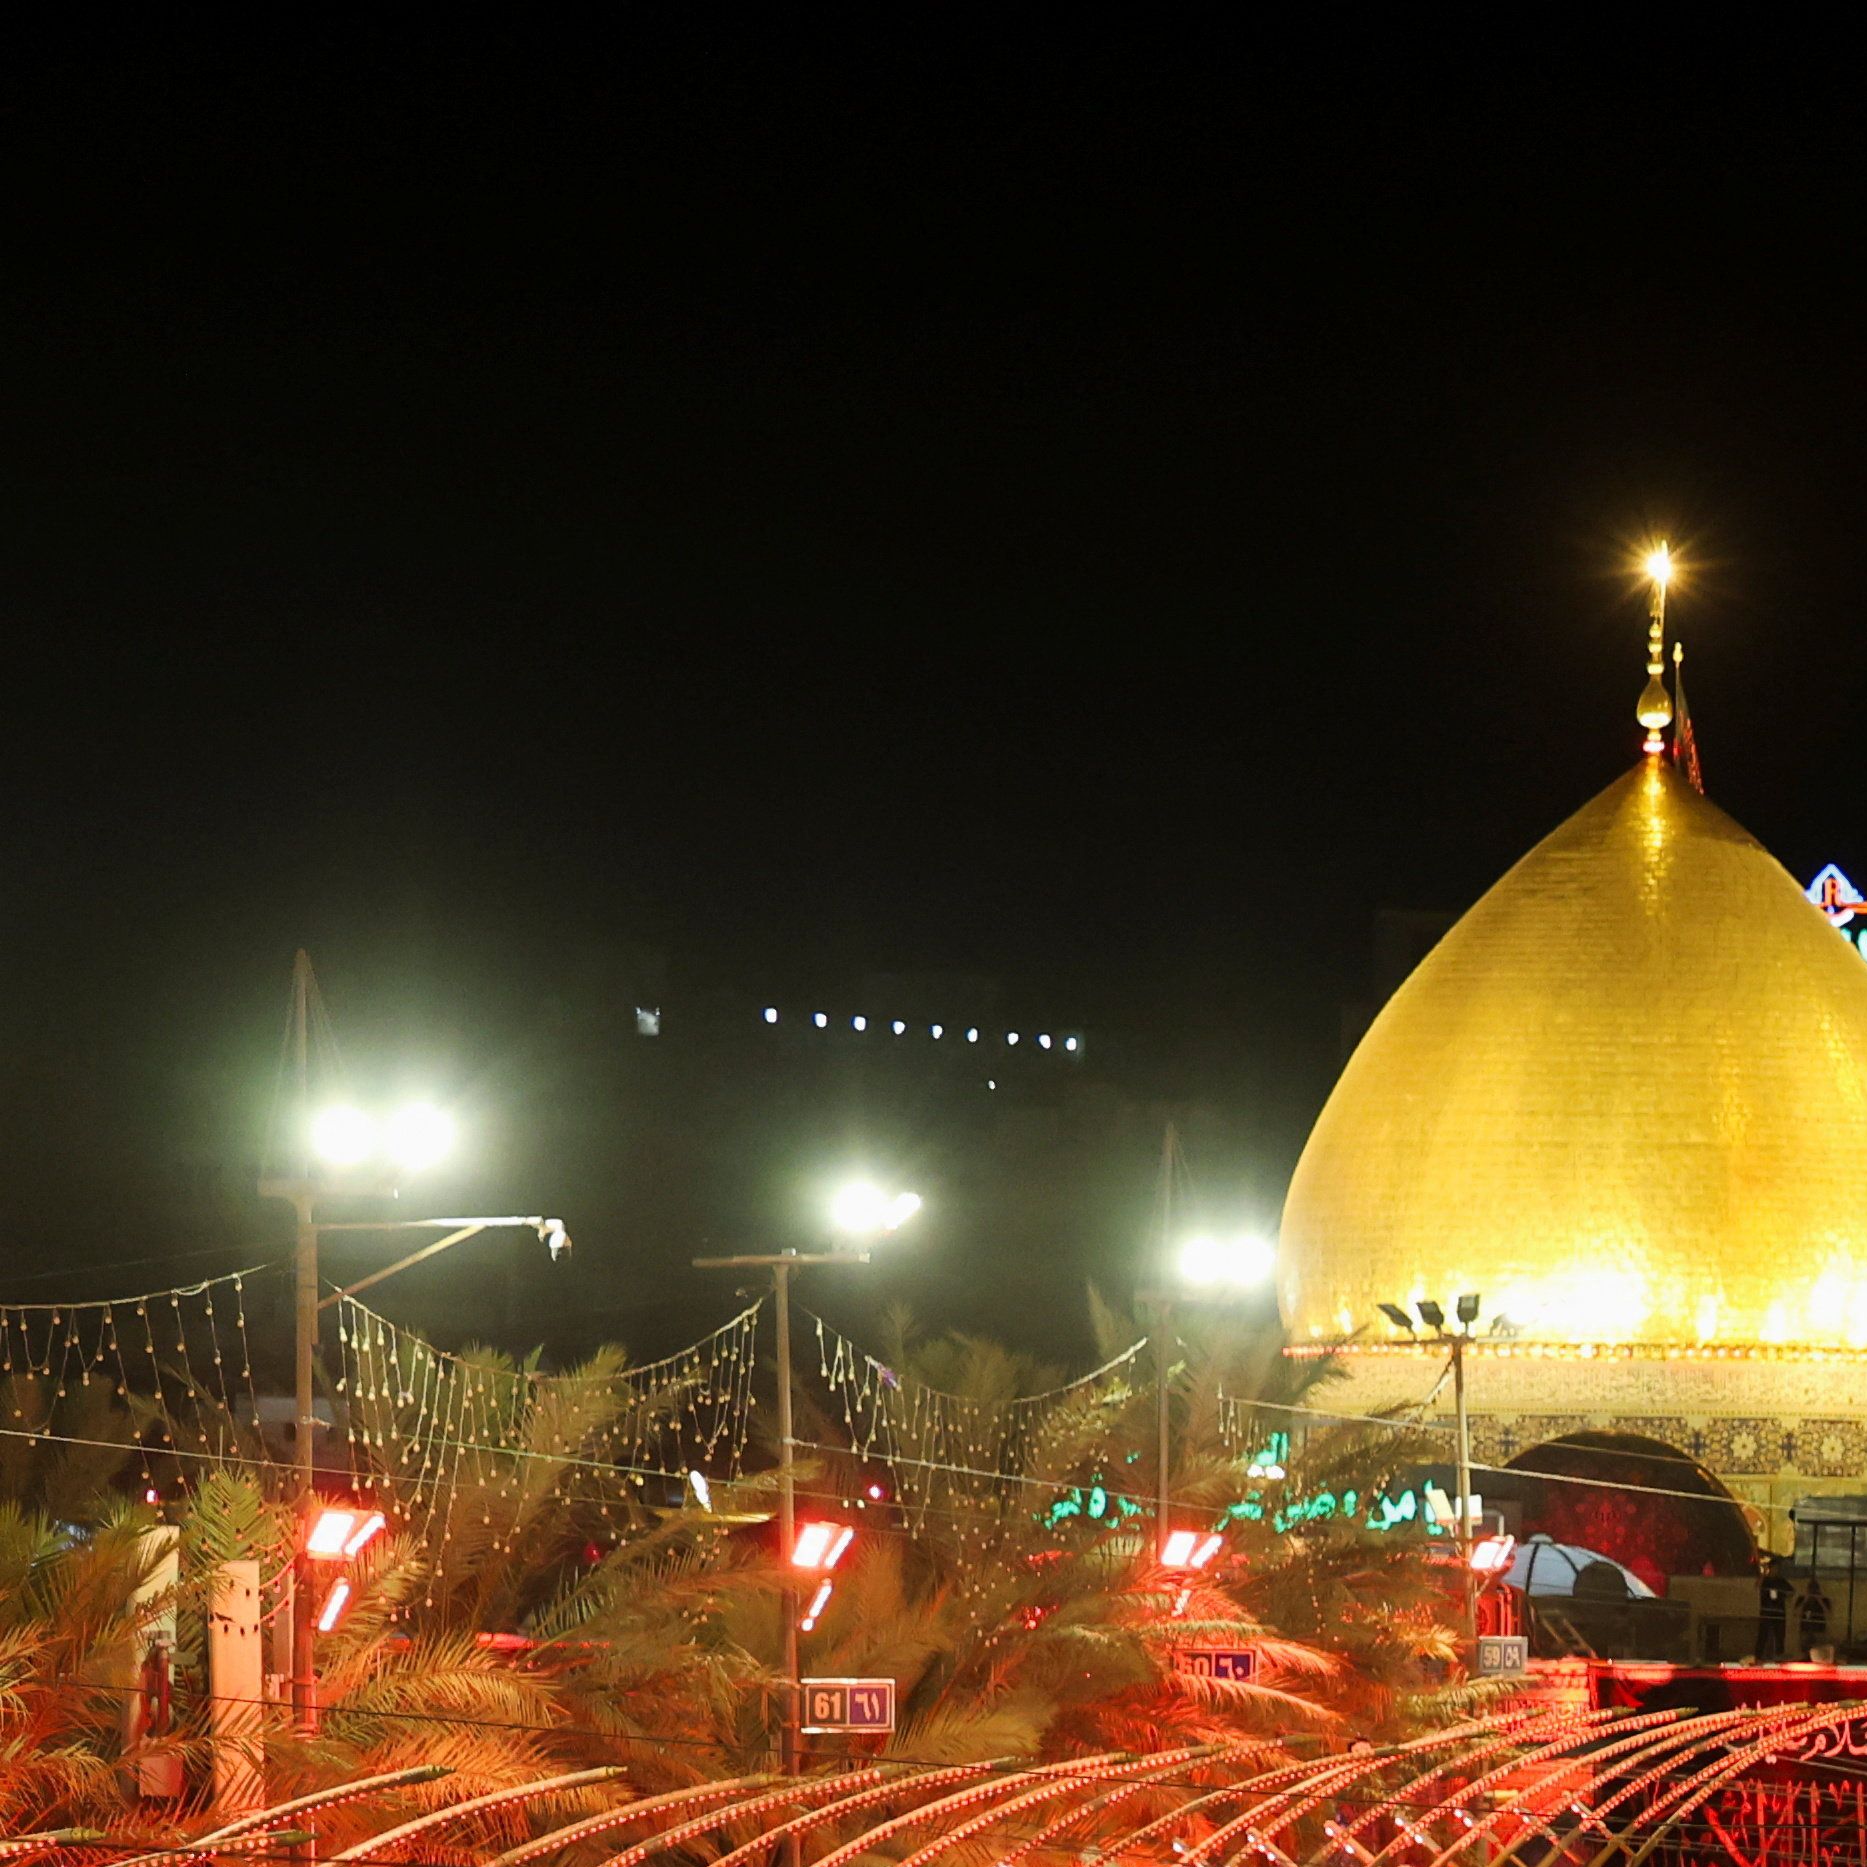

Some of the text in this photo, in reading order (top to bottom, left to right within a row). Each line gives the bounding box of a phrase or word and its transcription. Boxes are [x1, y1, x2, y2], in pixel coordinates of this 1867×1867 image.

[1484, 1653, 1498, 1669] 59
[814, 1692, 841, 1720] 61
[855, 1692, 880, 1720] ٦١
